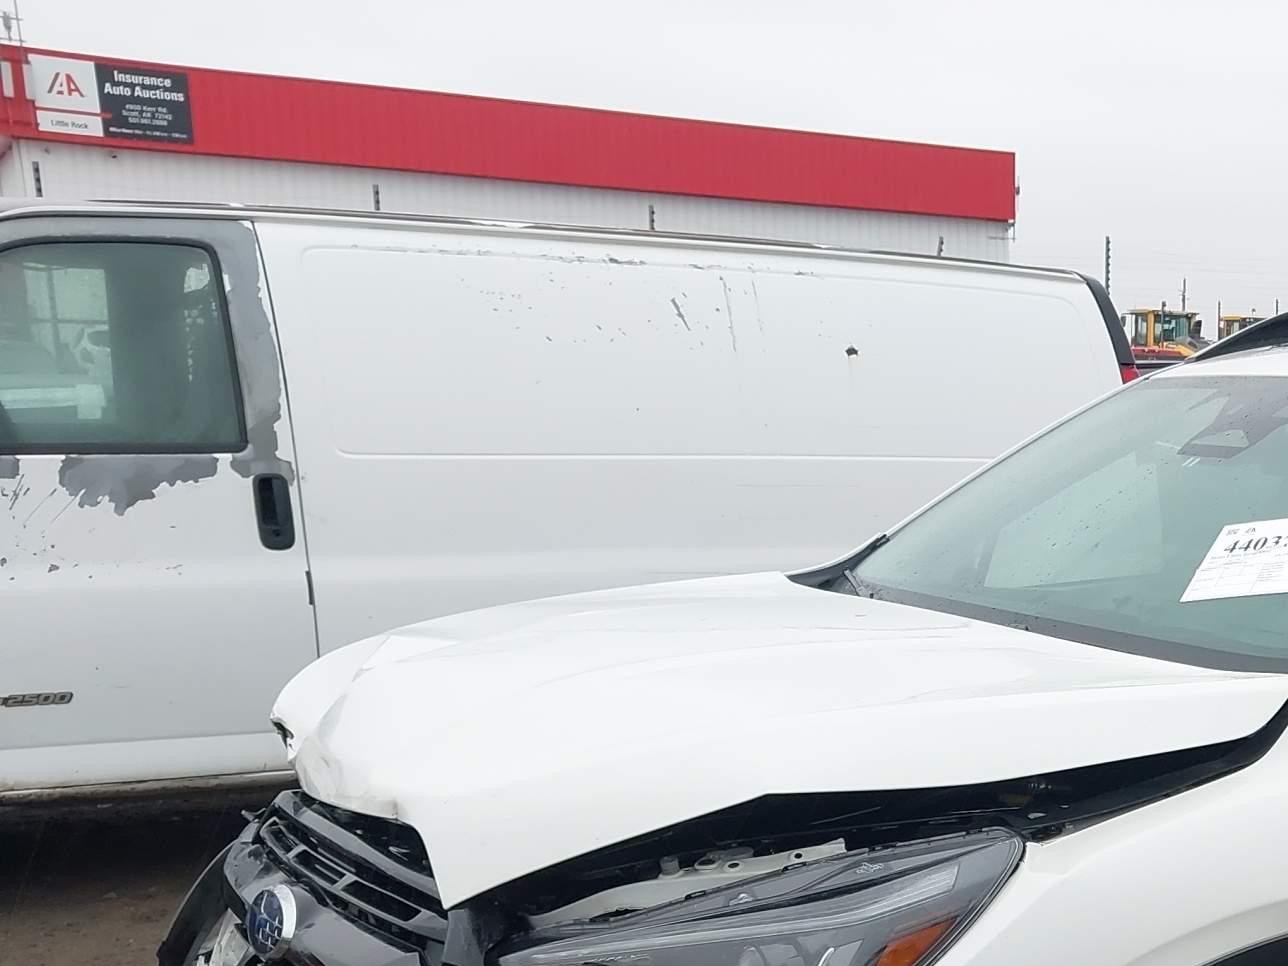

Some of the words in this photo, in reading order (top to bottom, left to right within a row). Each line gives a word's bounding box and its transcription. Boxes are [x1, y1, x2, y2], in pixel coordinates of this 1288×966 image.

[113, 69, 172, 87] Insurance
[104, 82, 132, 96] Auto
[134, 85, 185, 102] Auctions
[71, 120, 88, 129] Rock
[5, 692, 73, 707] 2500
